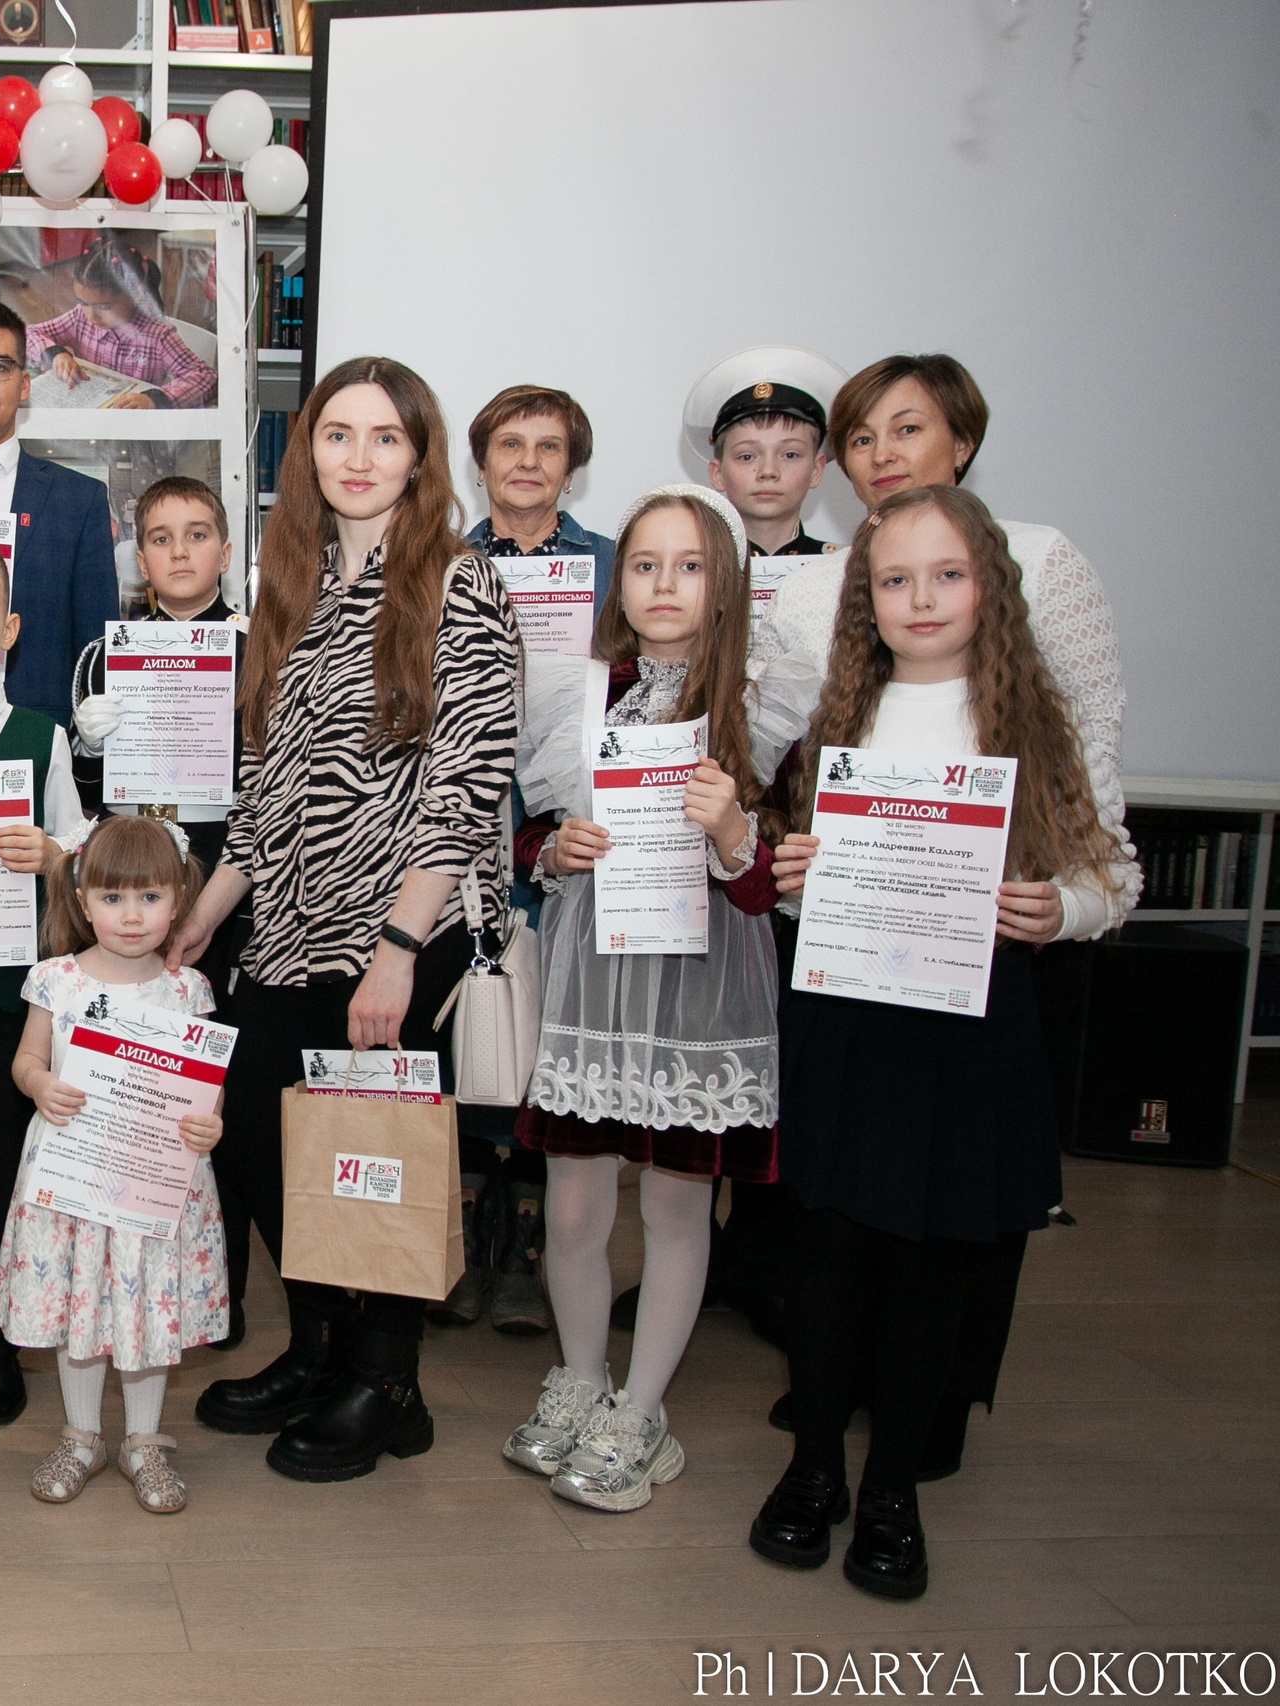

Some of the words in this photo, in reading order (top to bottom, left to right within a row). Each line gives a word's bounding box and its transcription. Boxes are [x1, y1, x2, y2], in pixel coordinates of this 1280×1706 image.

[255, 34, 265, 45] А
[548, 561, 564, 577] XI
[509, 594, 550, 602] ТВЕННОЕ
[551, 593, 591, 601] ПИСЬМО
[515, 611, 573, 619] ладимировне
[190, 628, 204, 644] XI
[142, 658, 195, 669] ДИПЛОМ
[943, 764, 966, 786] XI
[607, 807, 642, 815] Татьяне
[867, 801, 947, 819] ДИПЛОМ
[838, 837, 869, 846] Дарье
[871, 841, 926, 852] Андреевне
[928, 846, 973, 858] Каллаур
[961, 864, 988, 872] Канска
[182, 1024, 205, 1045] XI
[114, 1043, 182, 1071] ДИПЛОМ
[89, 1069, 116, 1083] Злате
[119, 1079, 192, 1104] Александровне
[110, 1087, 166, 1109] Бересневой
[337, 1159, 360, 1184] XI
[378, 1164, 400, 1176] БКЧ
[370, 1176, 397, 1184] БОЛЬШИЕ
[370, 1181, 397, 1189] КАНСКИЕ
